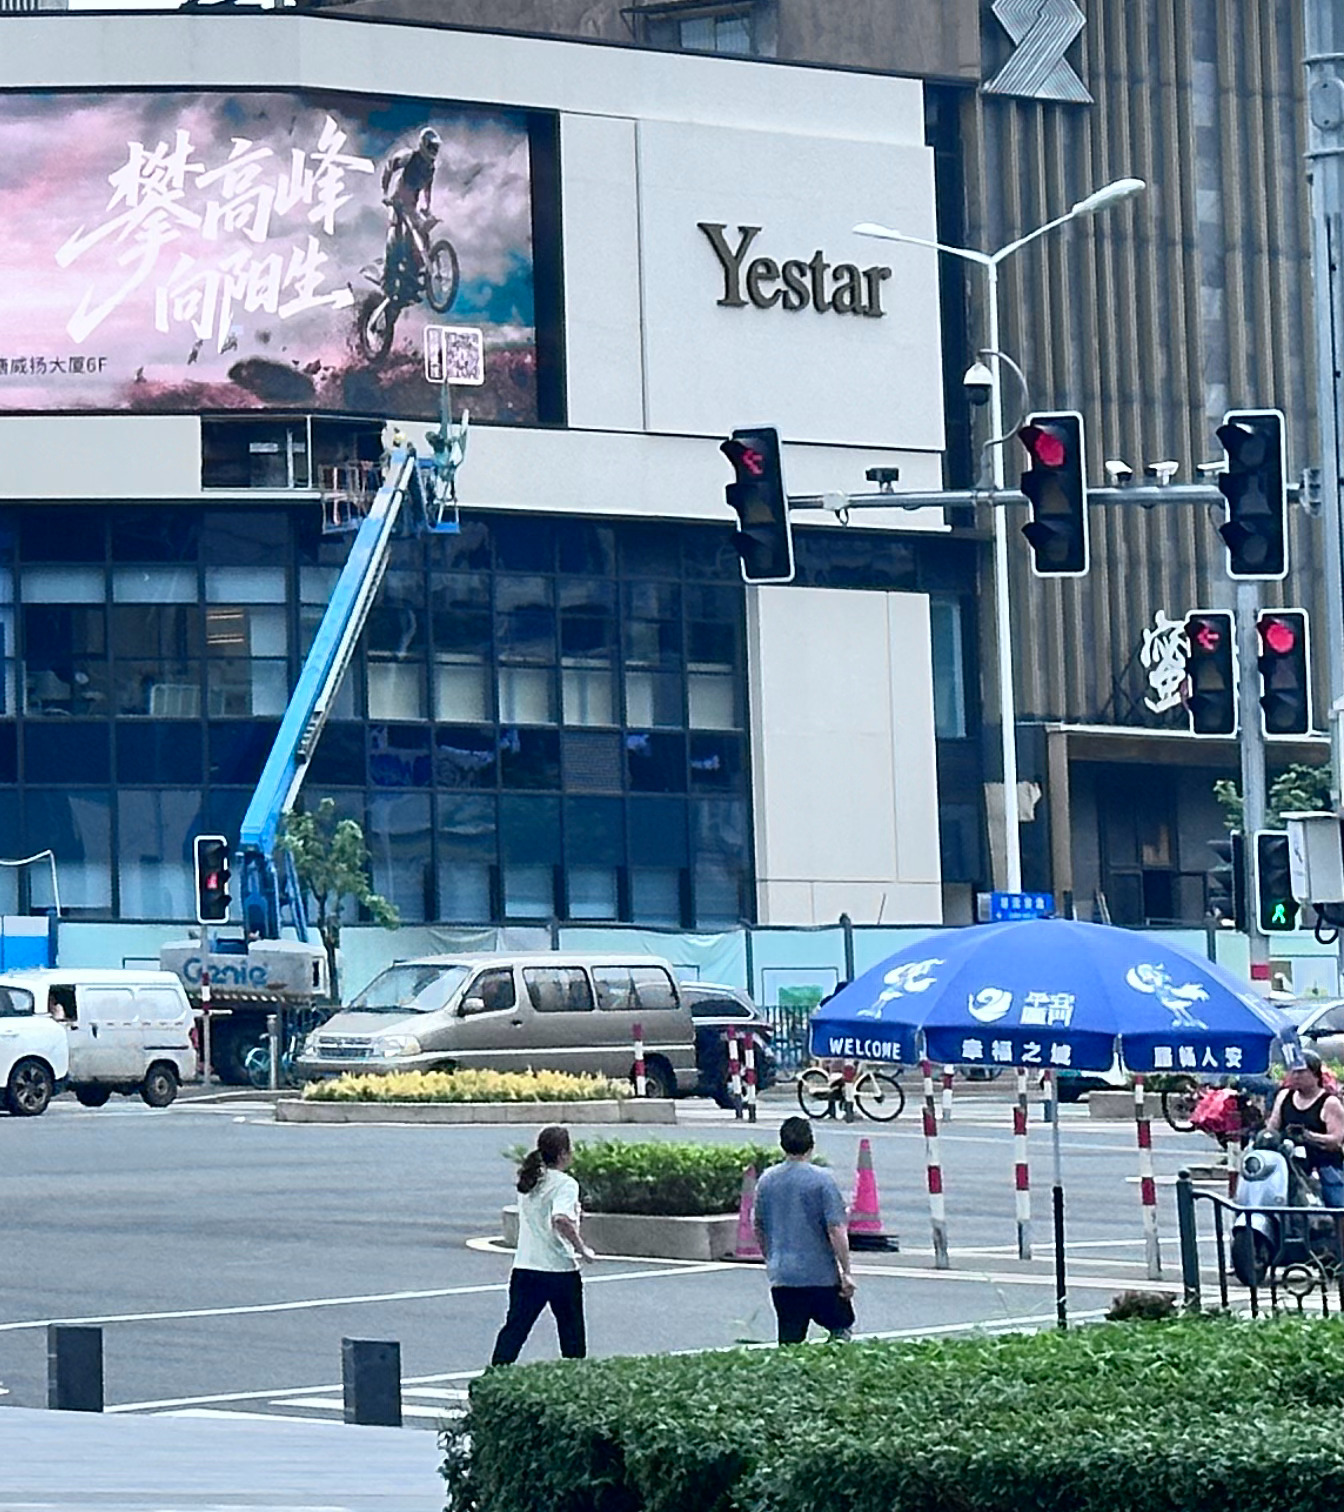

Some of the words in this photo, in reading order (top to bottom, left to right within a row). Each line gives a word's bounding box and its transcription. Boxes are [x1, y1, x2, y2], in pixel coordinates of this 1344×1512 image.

[55, 118, 374, 344] 攀高峰
[696, 222, 892, 318] Yestar
[155, 235, 354, 354] 向阳生
[183, 957, 268, 985] Genie
[829, 1037, 901, 1061] WELCOME
